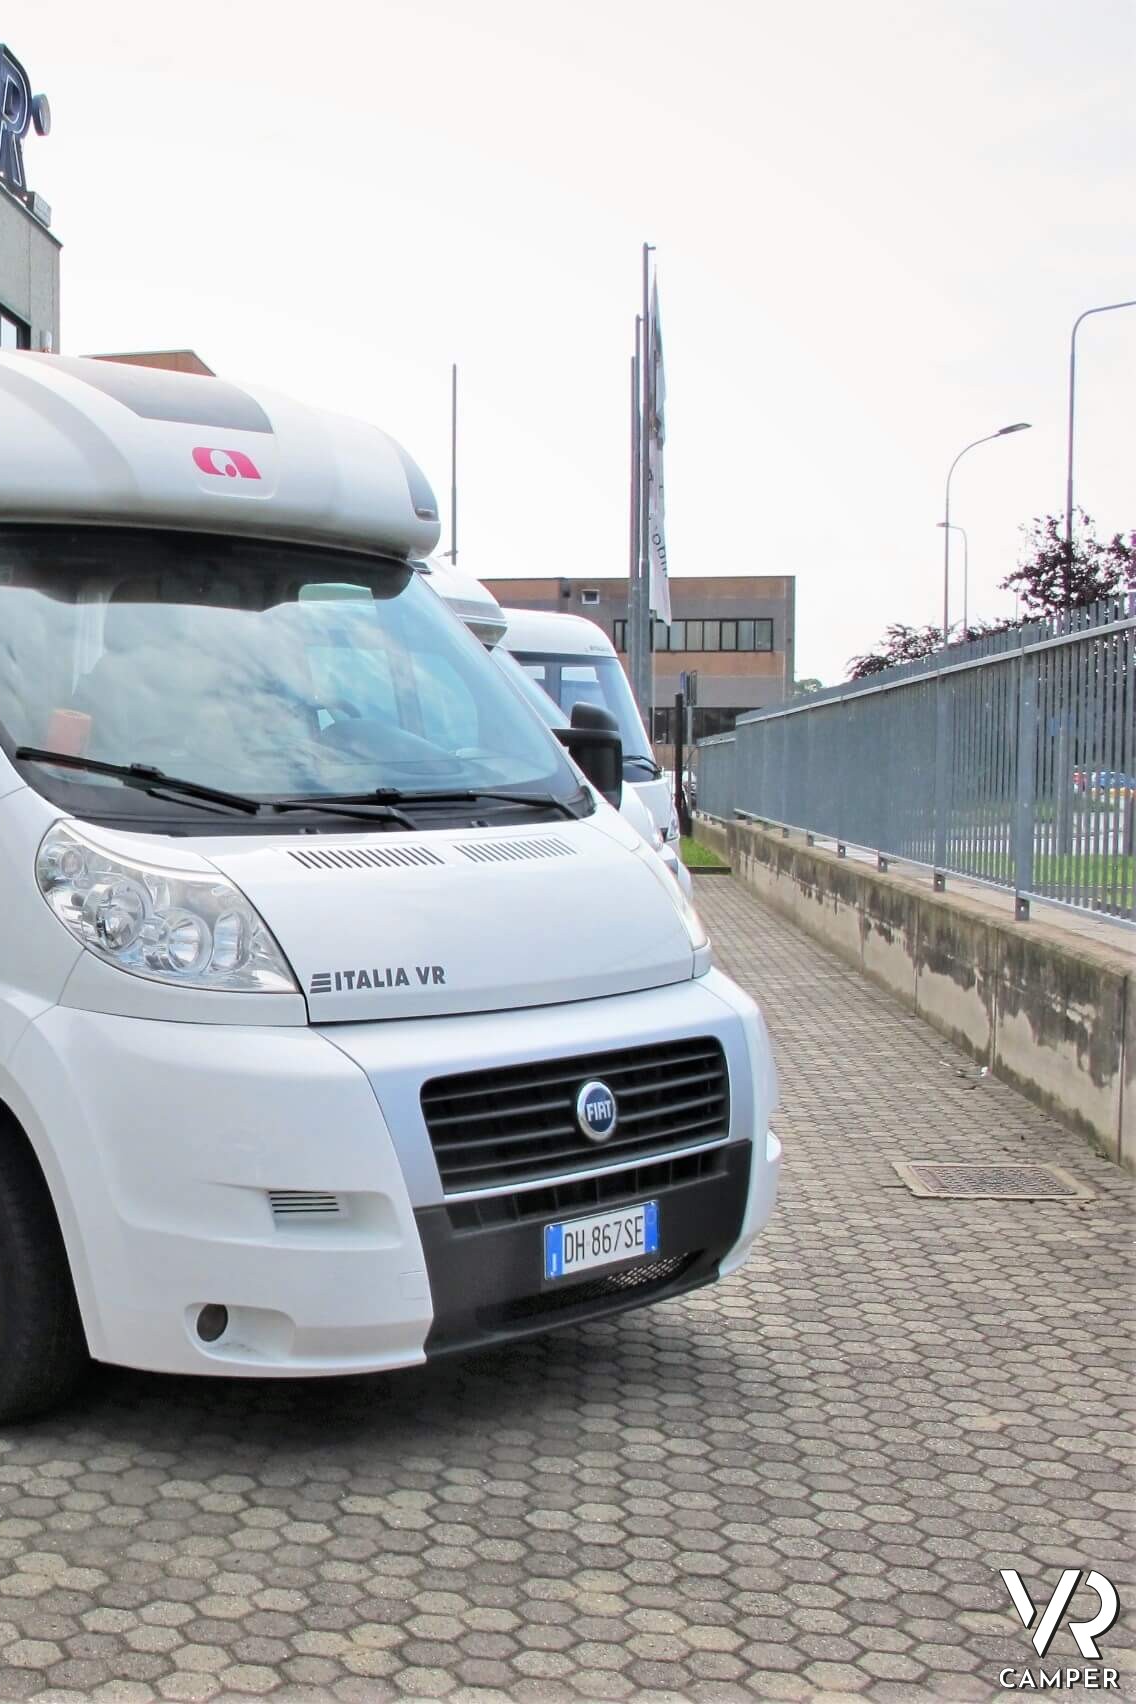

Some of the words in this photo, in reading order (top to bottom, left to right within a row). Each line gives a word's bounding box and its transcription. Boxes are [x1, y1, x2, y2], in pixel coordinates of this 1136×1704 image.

[335, 967, 410, 991] ITALIA
[415, 965, 446, 985] VR
[586, 1099, 612, 1122] FIAT
[564, 1229, 585, 1264] DH
[591, 1215, 644, 1256] 867SE
